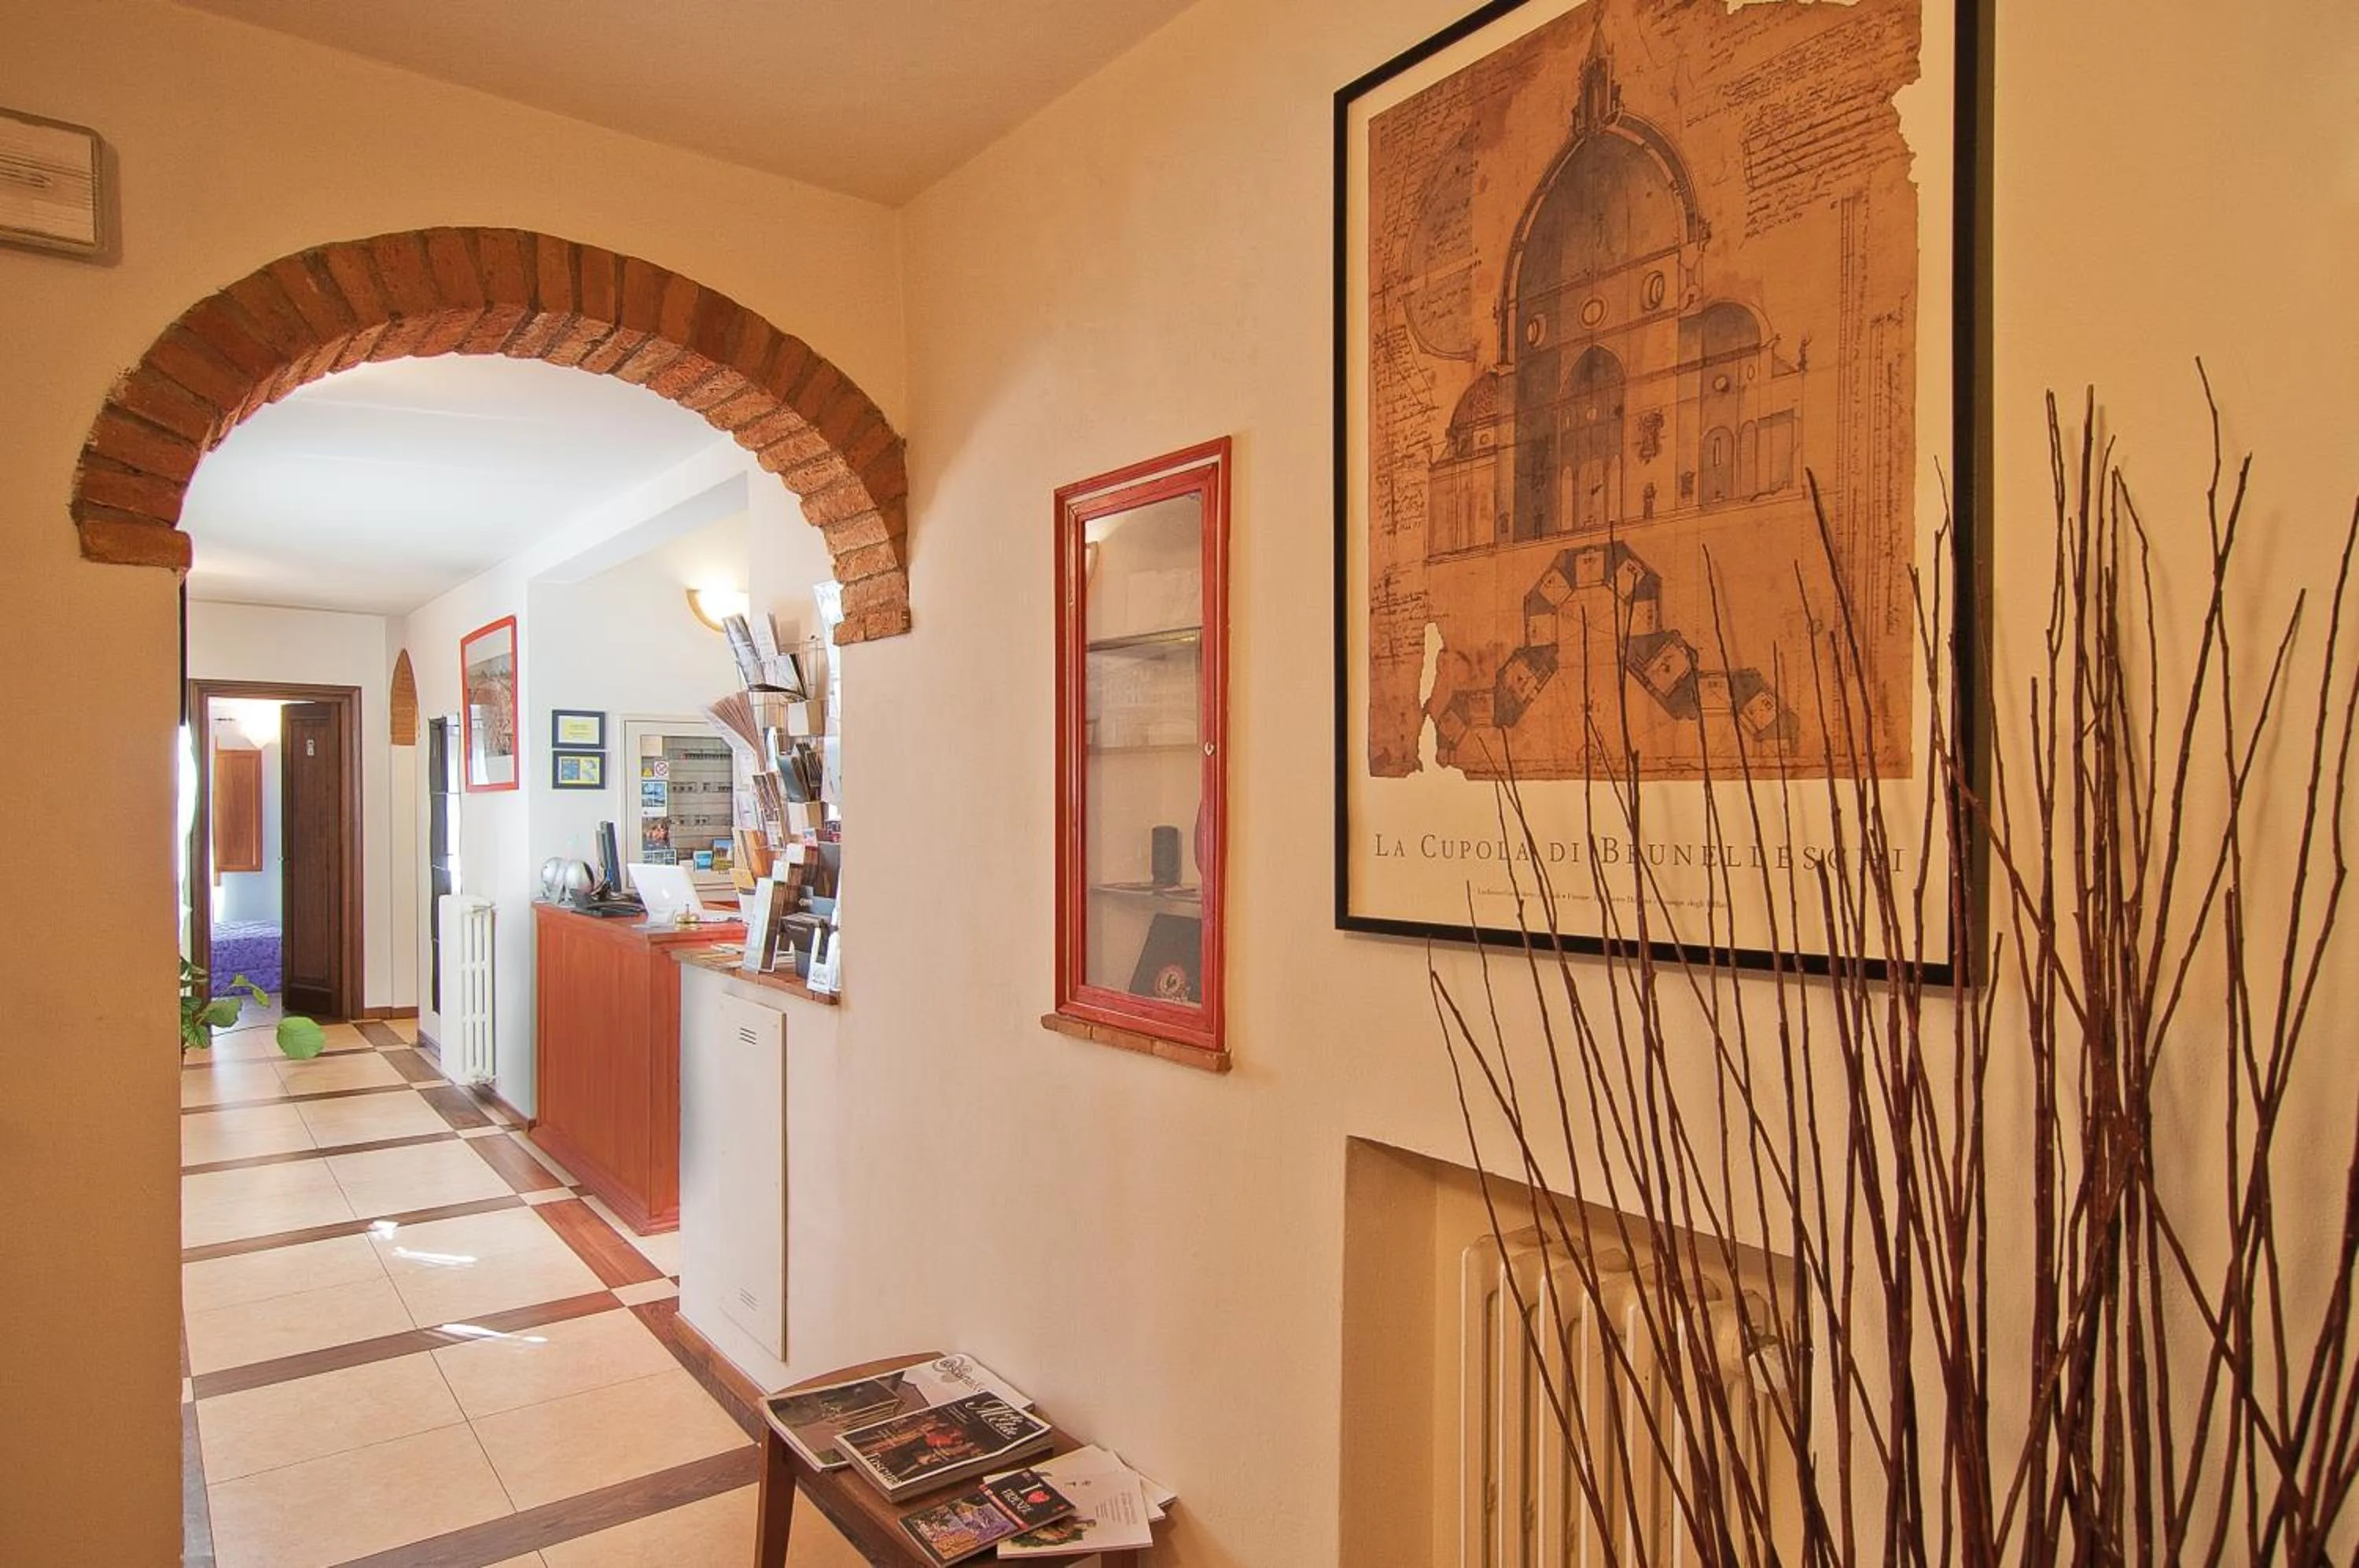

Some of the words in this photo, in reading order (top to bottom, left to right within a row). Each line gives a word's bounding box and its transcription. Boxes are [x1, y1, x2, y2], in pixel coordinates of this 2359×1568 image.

[1375, 833, 1406, 859] LA
[1420, 834, 1530, 862] CUPOLA
[1549, 842, 1581, 863] DI
[1600, 836, 1907, 872] BUNELLESCI
